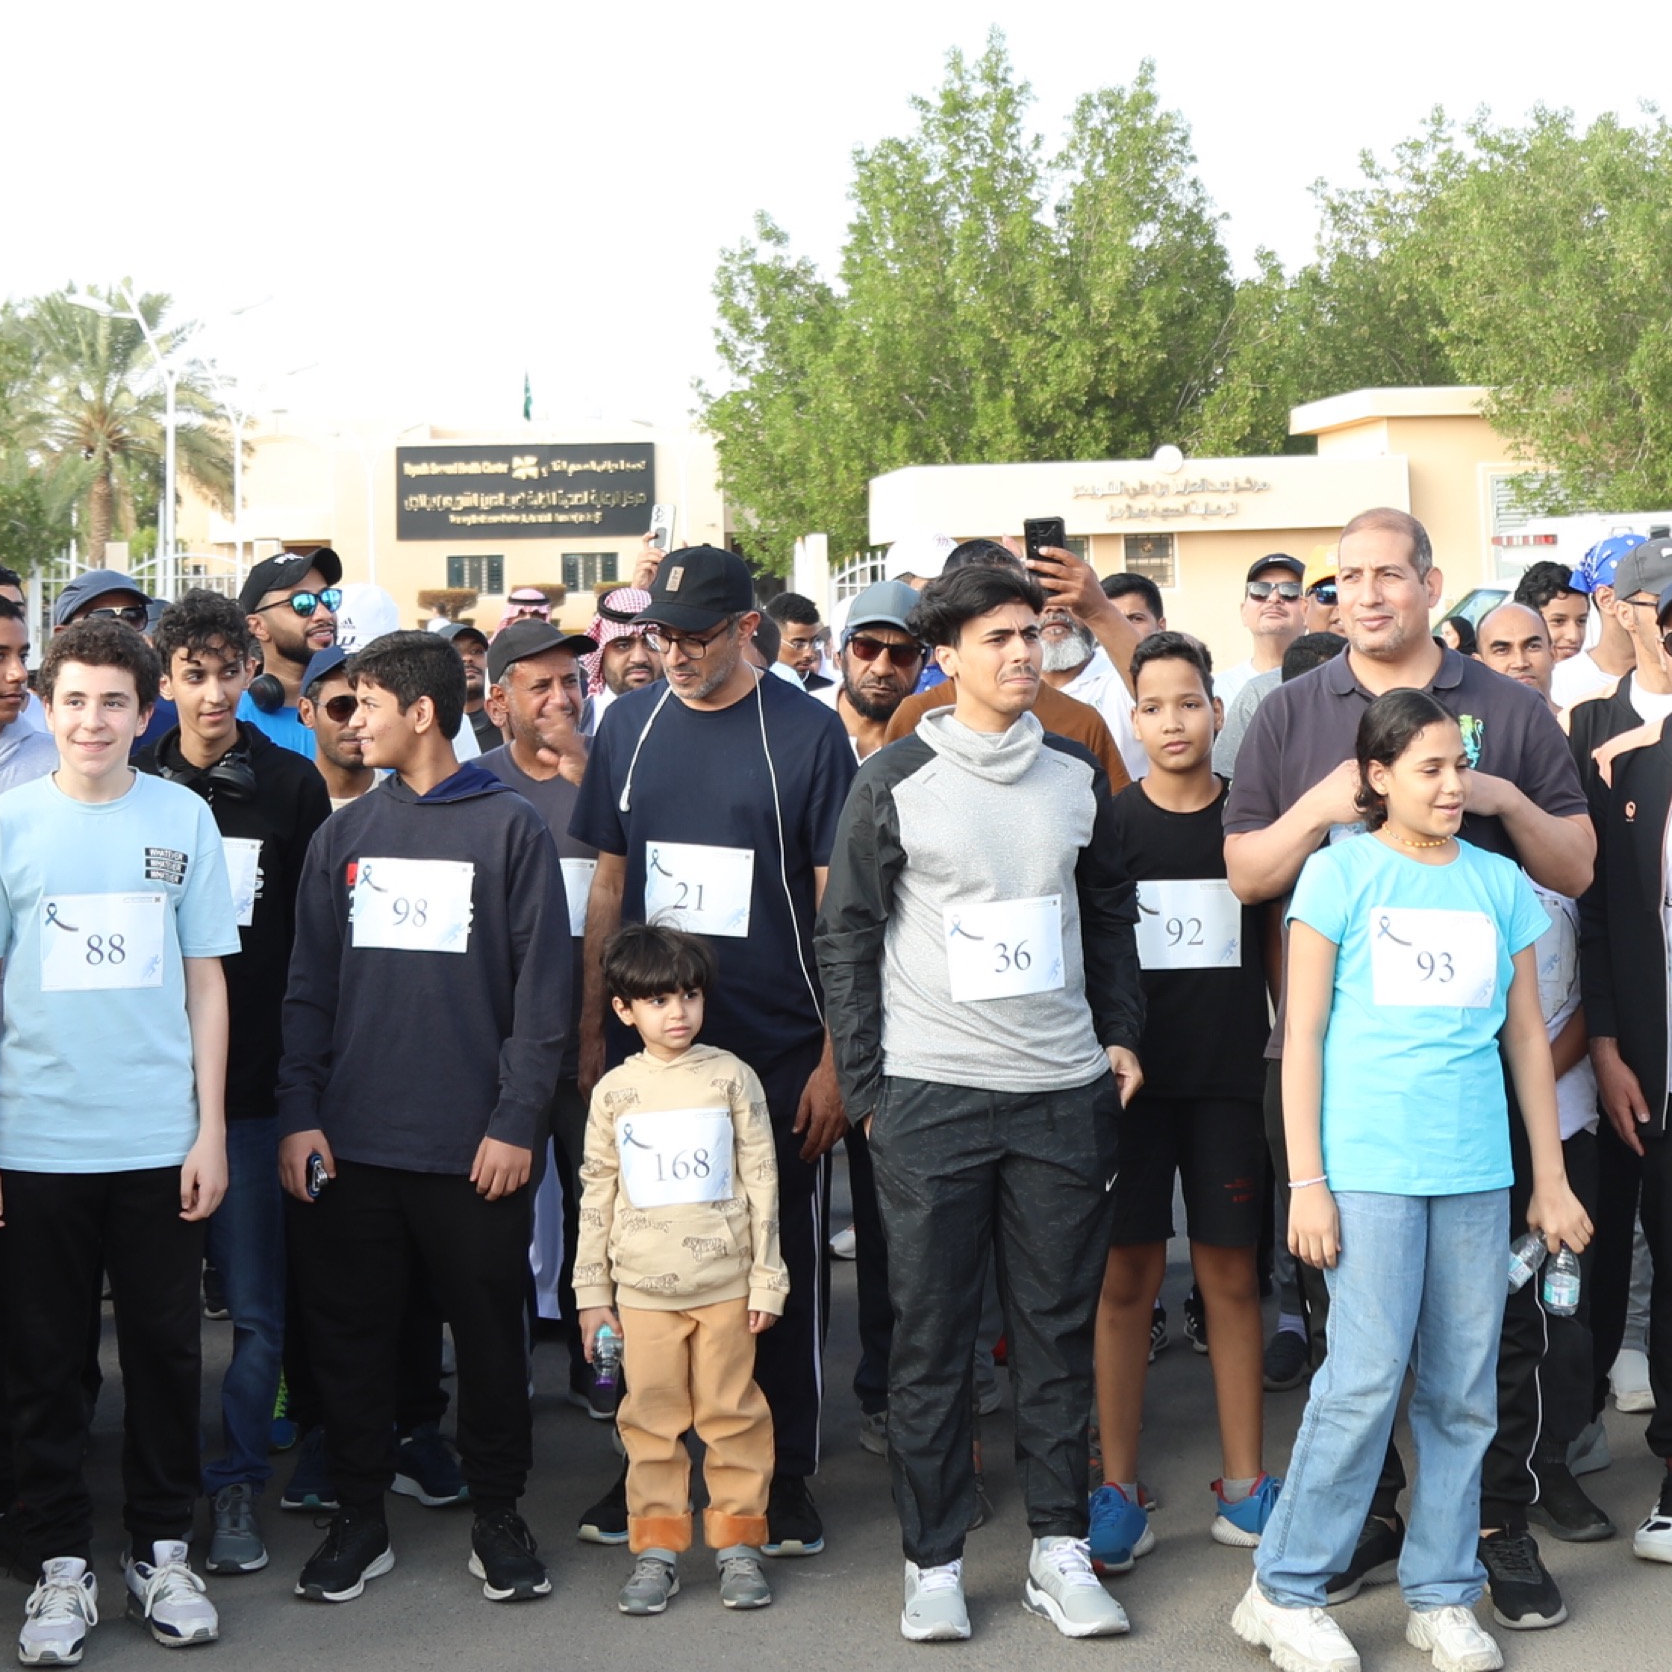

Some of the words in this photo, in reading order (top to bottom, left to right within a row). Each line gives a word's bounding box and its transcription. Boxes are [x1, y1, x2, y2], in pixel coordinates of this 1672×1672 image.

[393, 896, 428, 928] 98
[673, 881, 704, 911] 21
[1165, 917, 1204, 947] 92
[85, 933, 126, 965] 88
[994, 938, 1032, 973] 36
[1416, 950, 1455, 983] 93
[655, 1148, 710, 1182] 168
